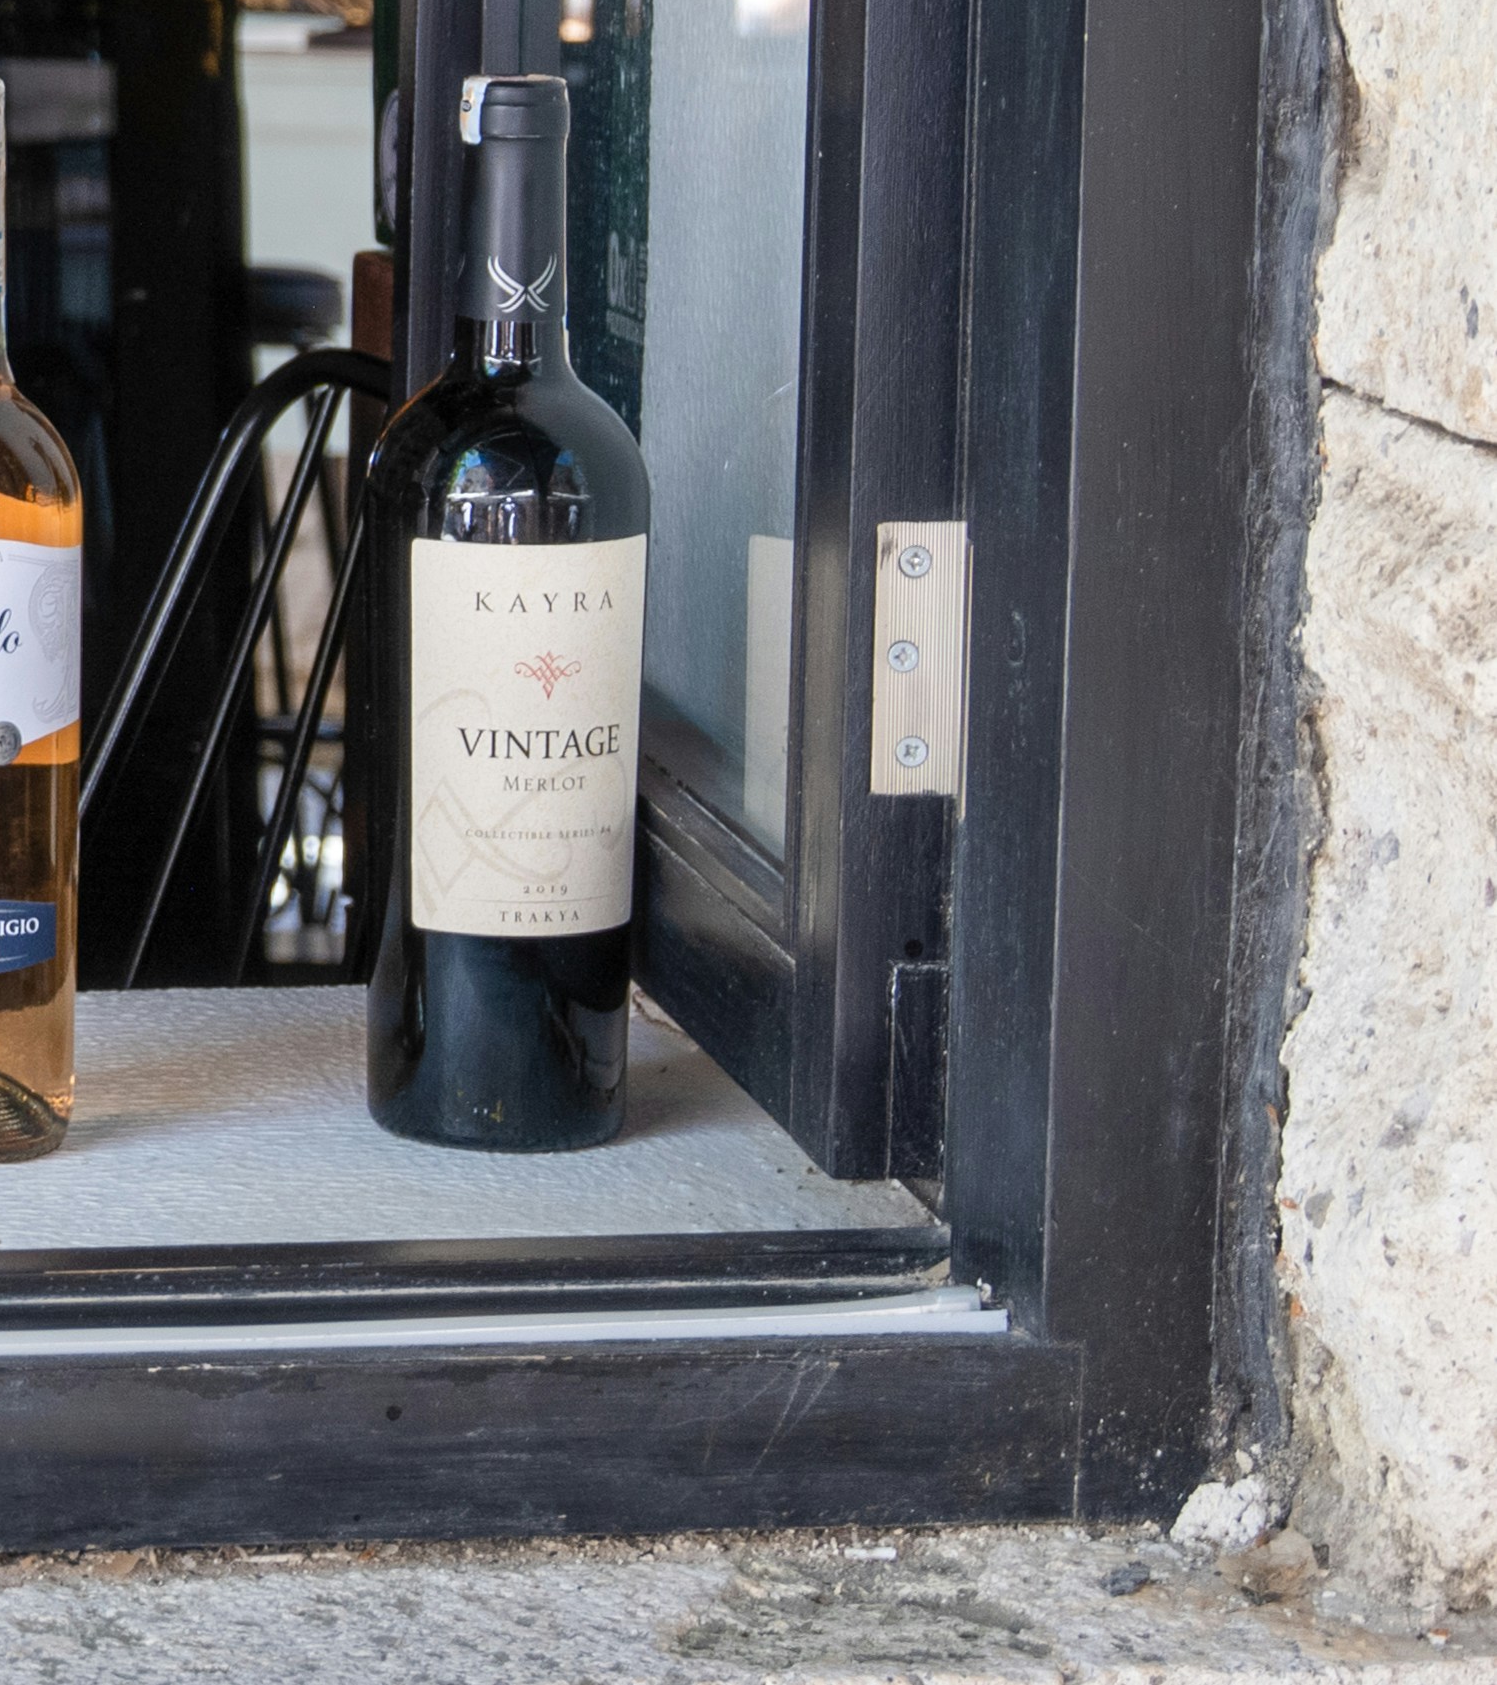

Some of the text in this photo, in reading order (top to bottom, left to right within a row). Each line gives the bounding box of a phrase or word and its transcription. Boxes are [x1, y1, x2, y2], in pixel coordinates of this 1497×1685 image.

[474, 589, 614, 614] KAYRA
[458, 724, 621, 760] VINTAGE
[502, 775, 587, 793] MERLOT
[522, 883, 570, 896] 2019
[500, 909, 581, 924] TRAKYA
